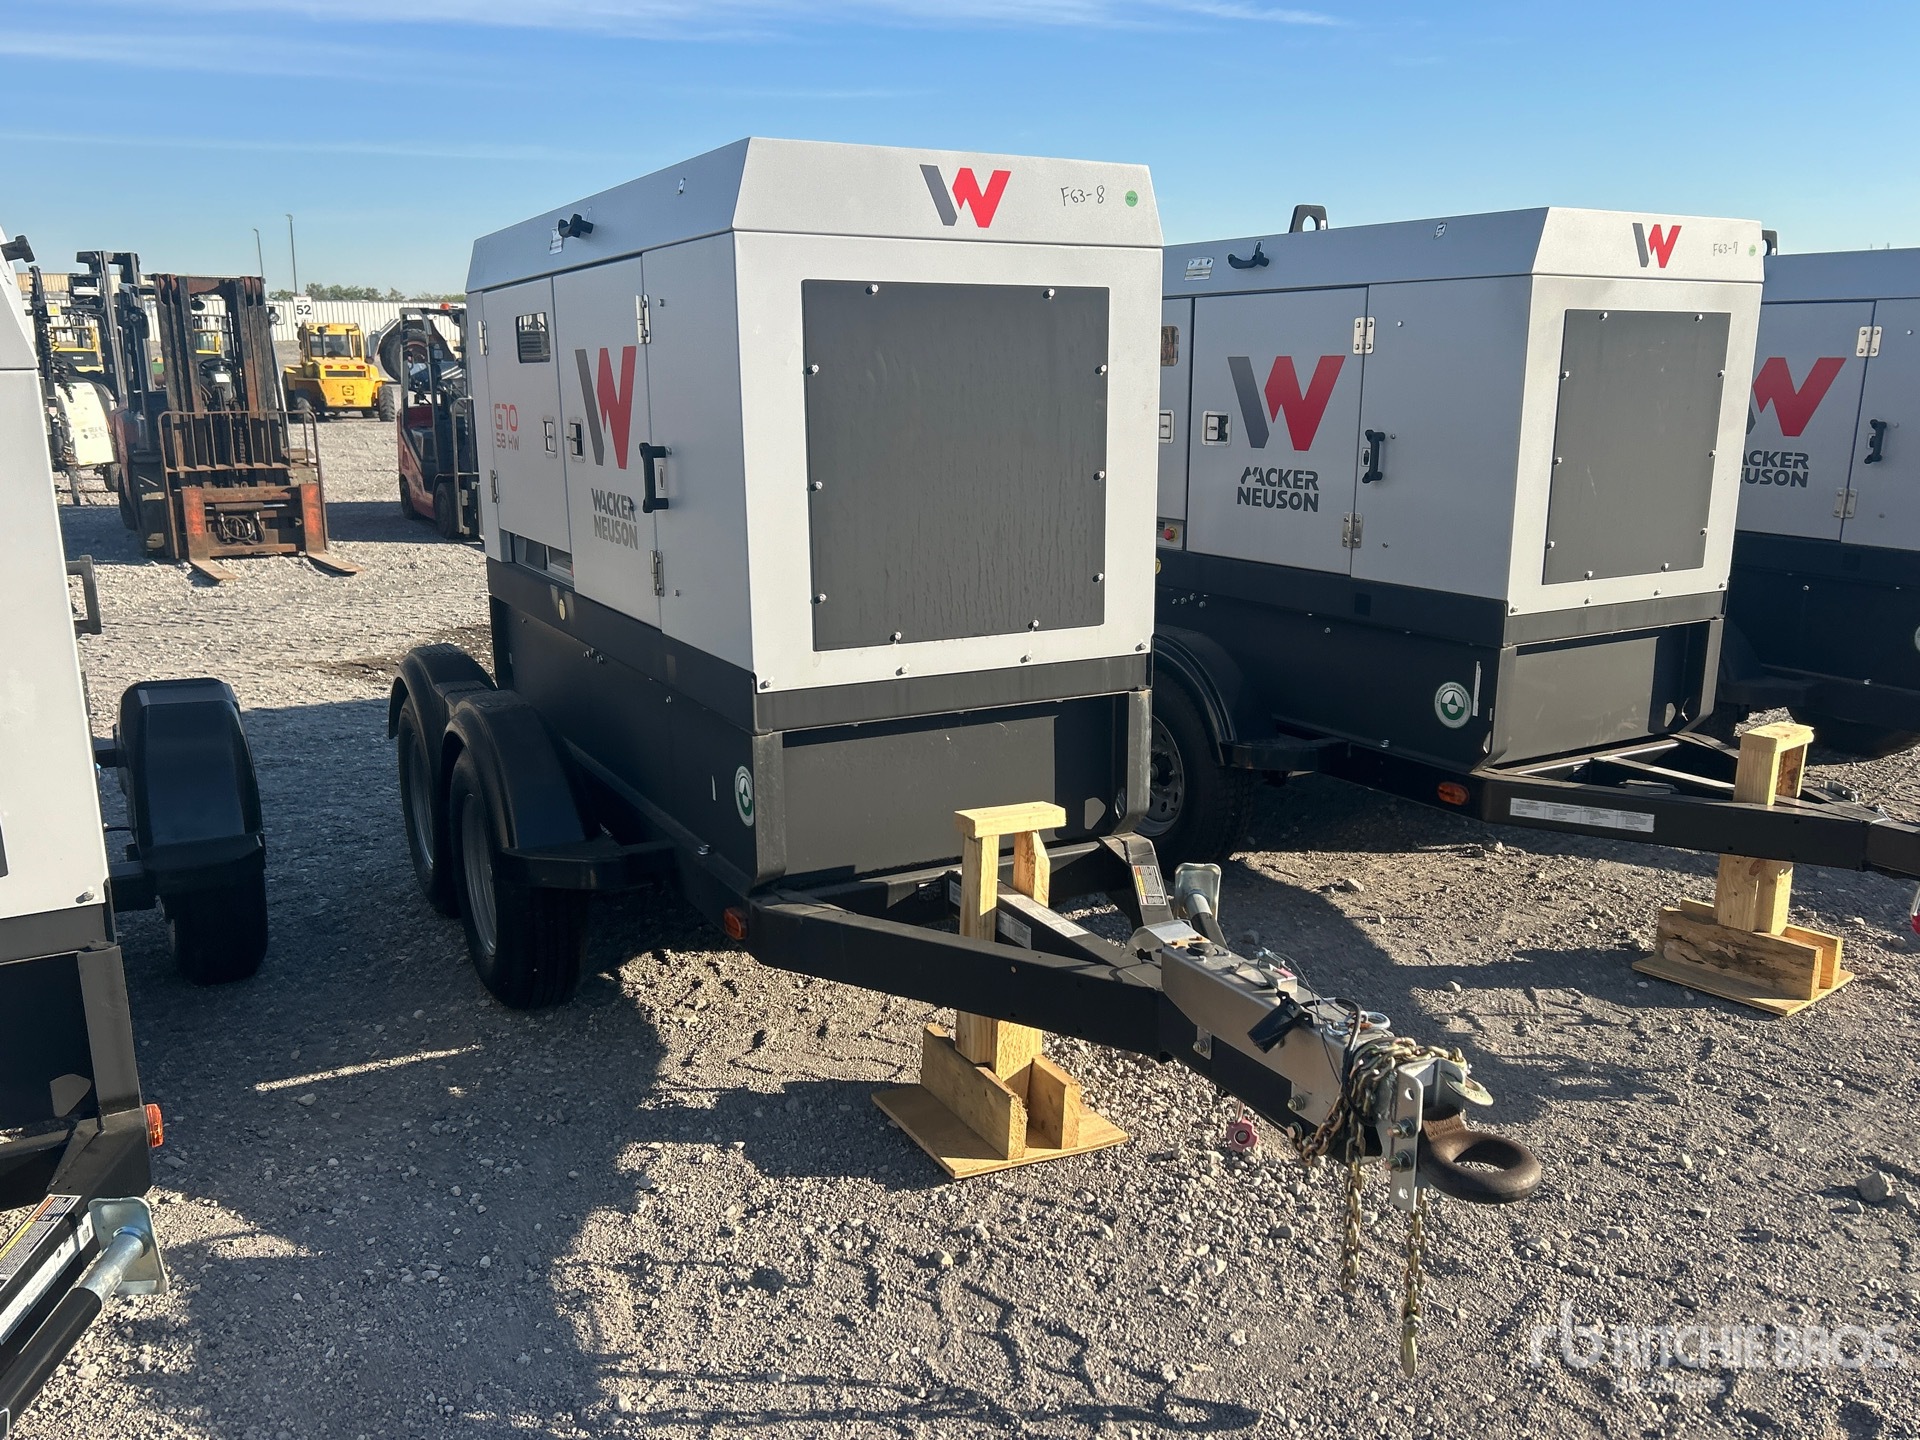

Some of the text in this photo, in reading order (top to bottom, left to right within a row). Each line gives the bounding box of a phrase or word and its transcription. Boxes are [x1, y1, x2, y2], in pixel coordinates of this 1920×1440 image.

[1060, 185, 1105, 206] F63-8
[296, 304, 312, 315] 52
[494, 403, 518, 432] G70
[1742, 450, 1809, 470] ACKER
[1740, 468, 1809, 488] USON
[591, 487, 637, 522] WACKER
[1237, 486, 1319, 512] NEUSON
[593, 514, 638, 550] NEUSON
